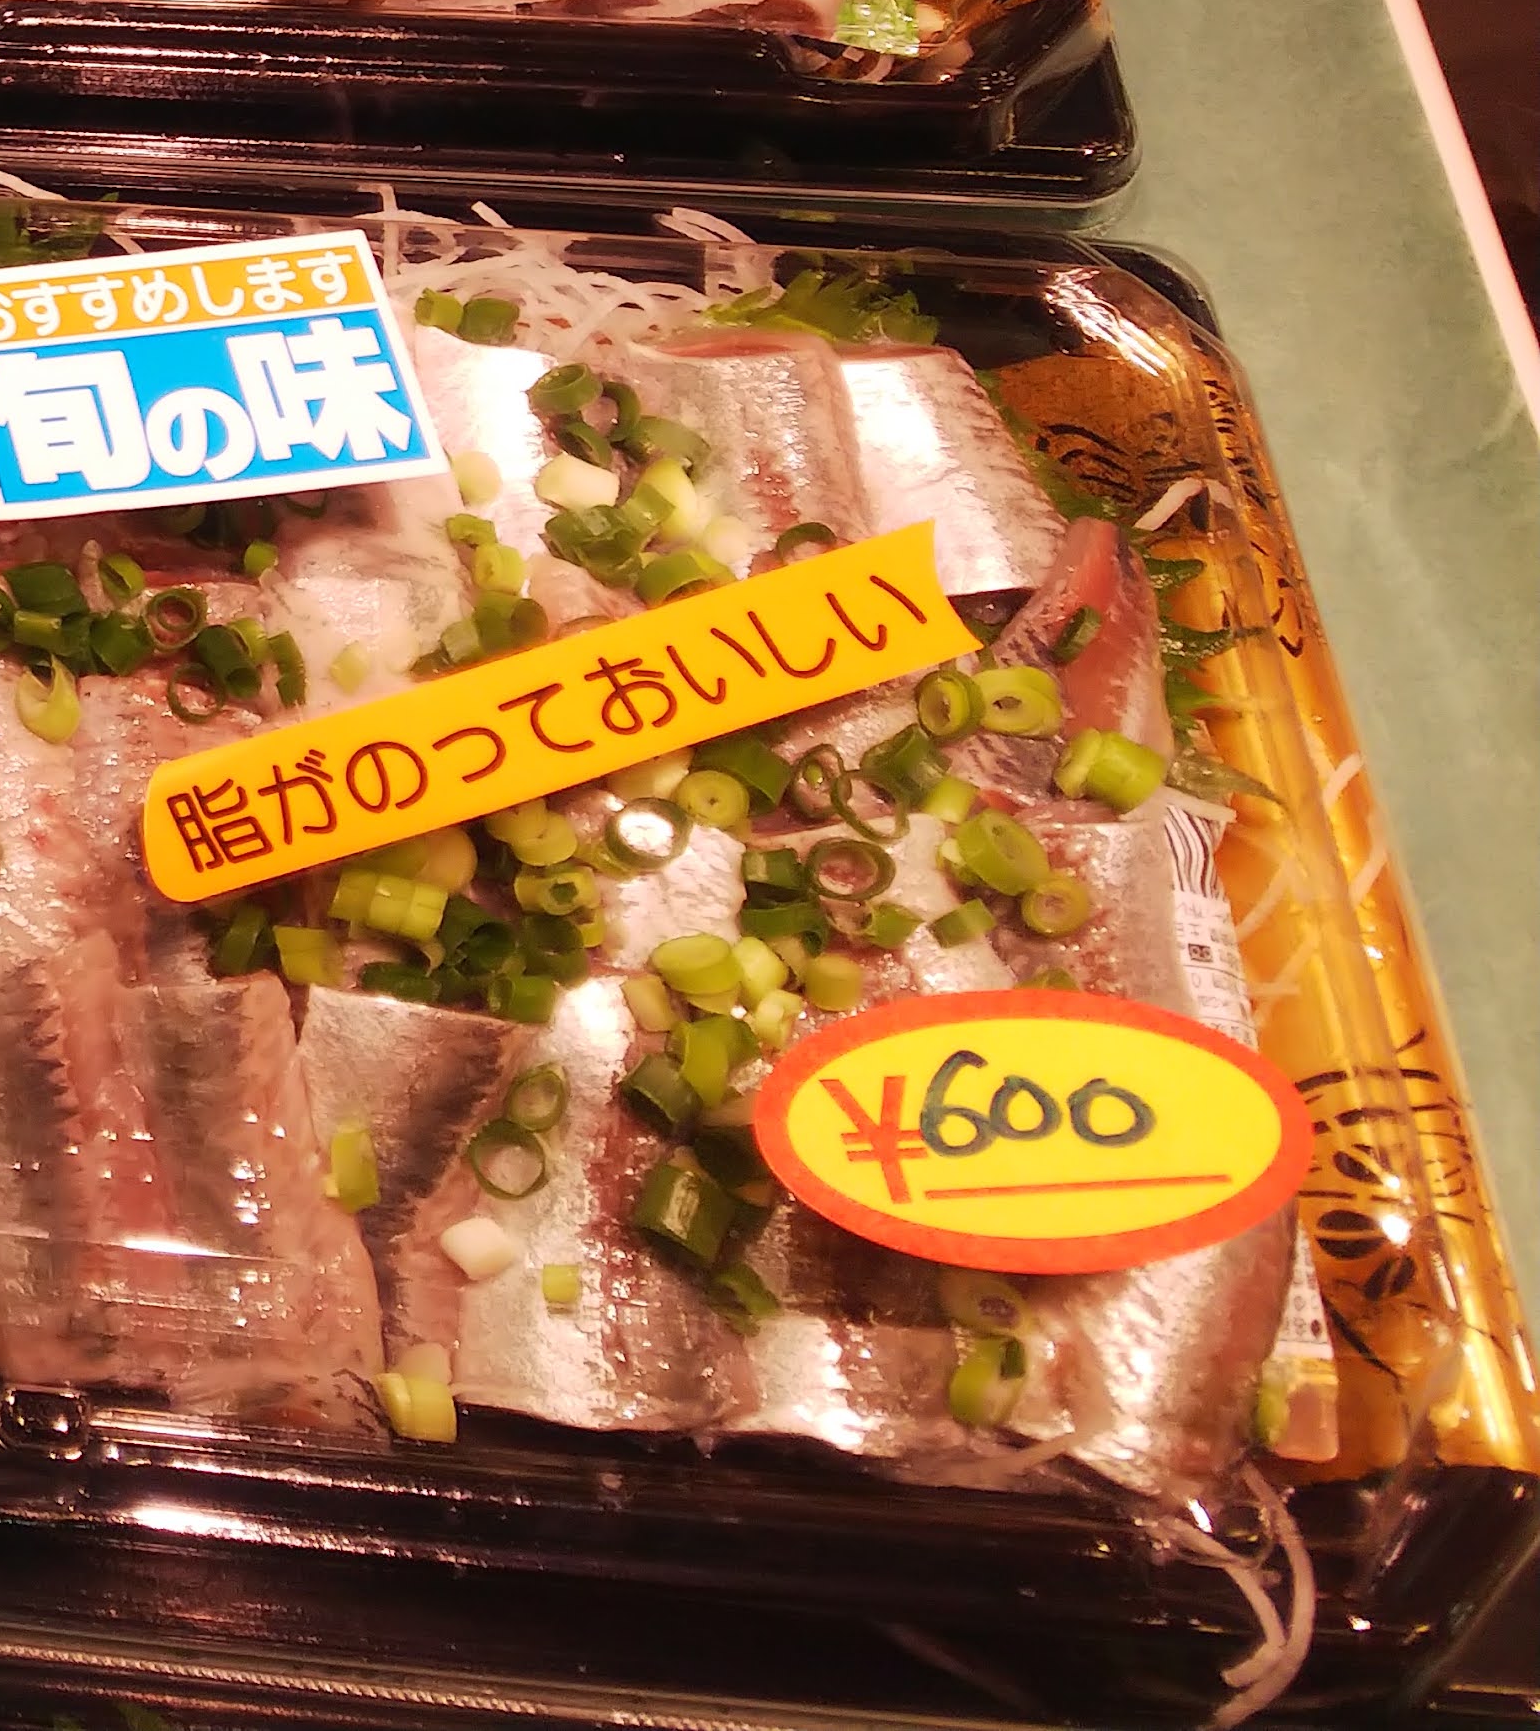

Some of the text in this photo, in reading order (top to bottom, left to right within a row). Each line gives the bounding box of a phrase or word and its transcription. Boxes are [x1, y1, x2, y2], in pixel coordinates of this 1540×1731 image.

[167, 573, 927, 874] 脂がのっておいしい
[819, 1049, 1156, 1205] ¥600
